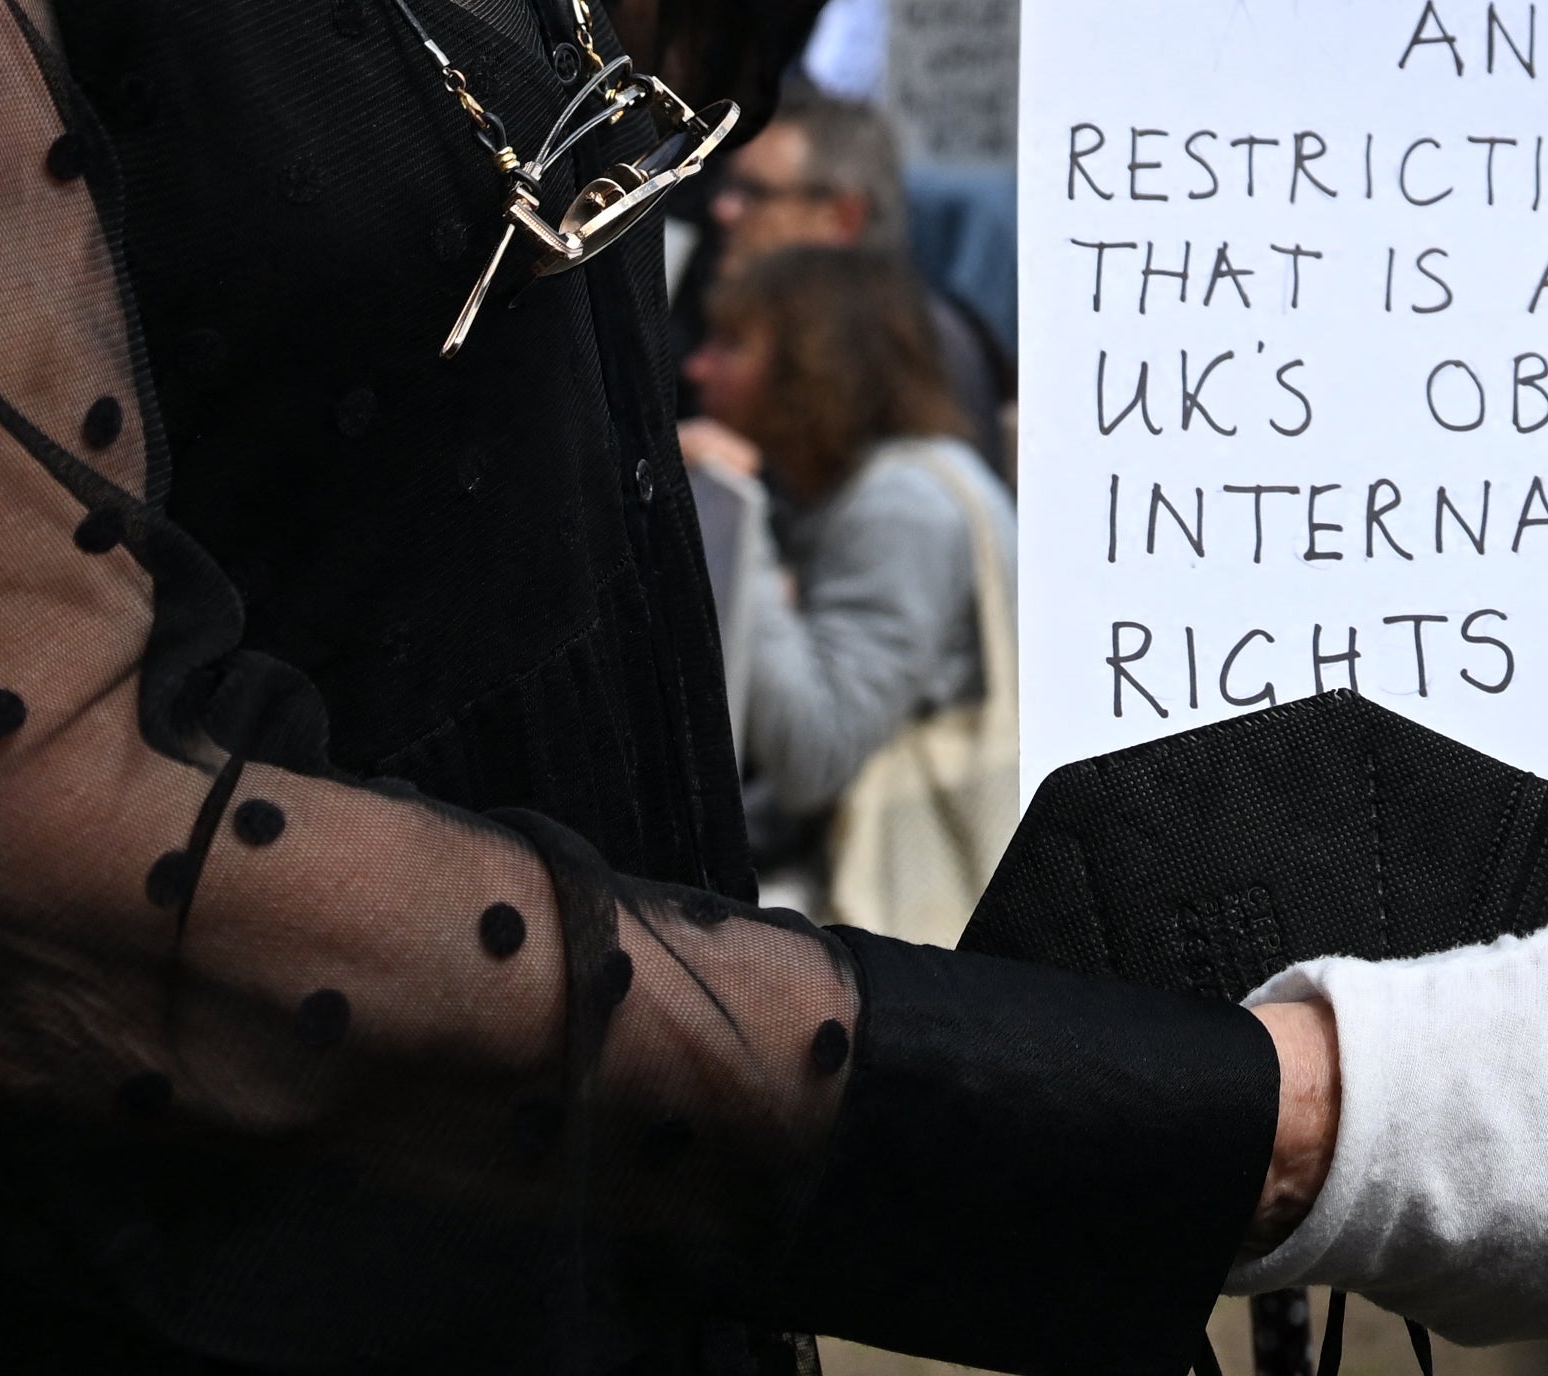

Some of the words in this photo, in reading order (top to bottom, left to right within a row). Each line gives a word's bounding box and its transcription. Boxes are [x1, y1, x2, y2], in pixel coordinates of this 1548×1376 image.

[1398, 0, 1536, 79] AN
[1070, 238, 1323, 315] THAT
[1385, 247, 1453, 314] IS
[1097, 341, 1312, 437] UK'S
[1106, 609, 1514, 718] RIGHTS
